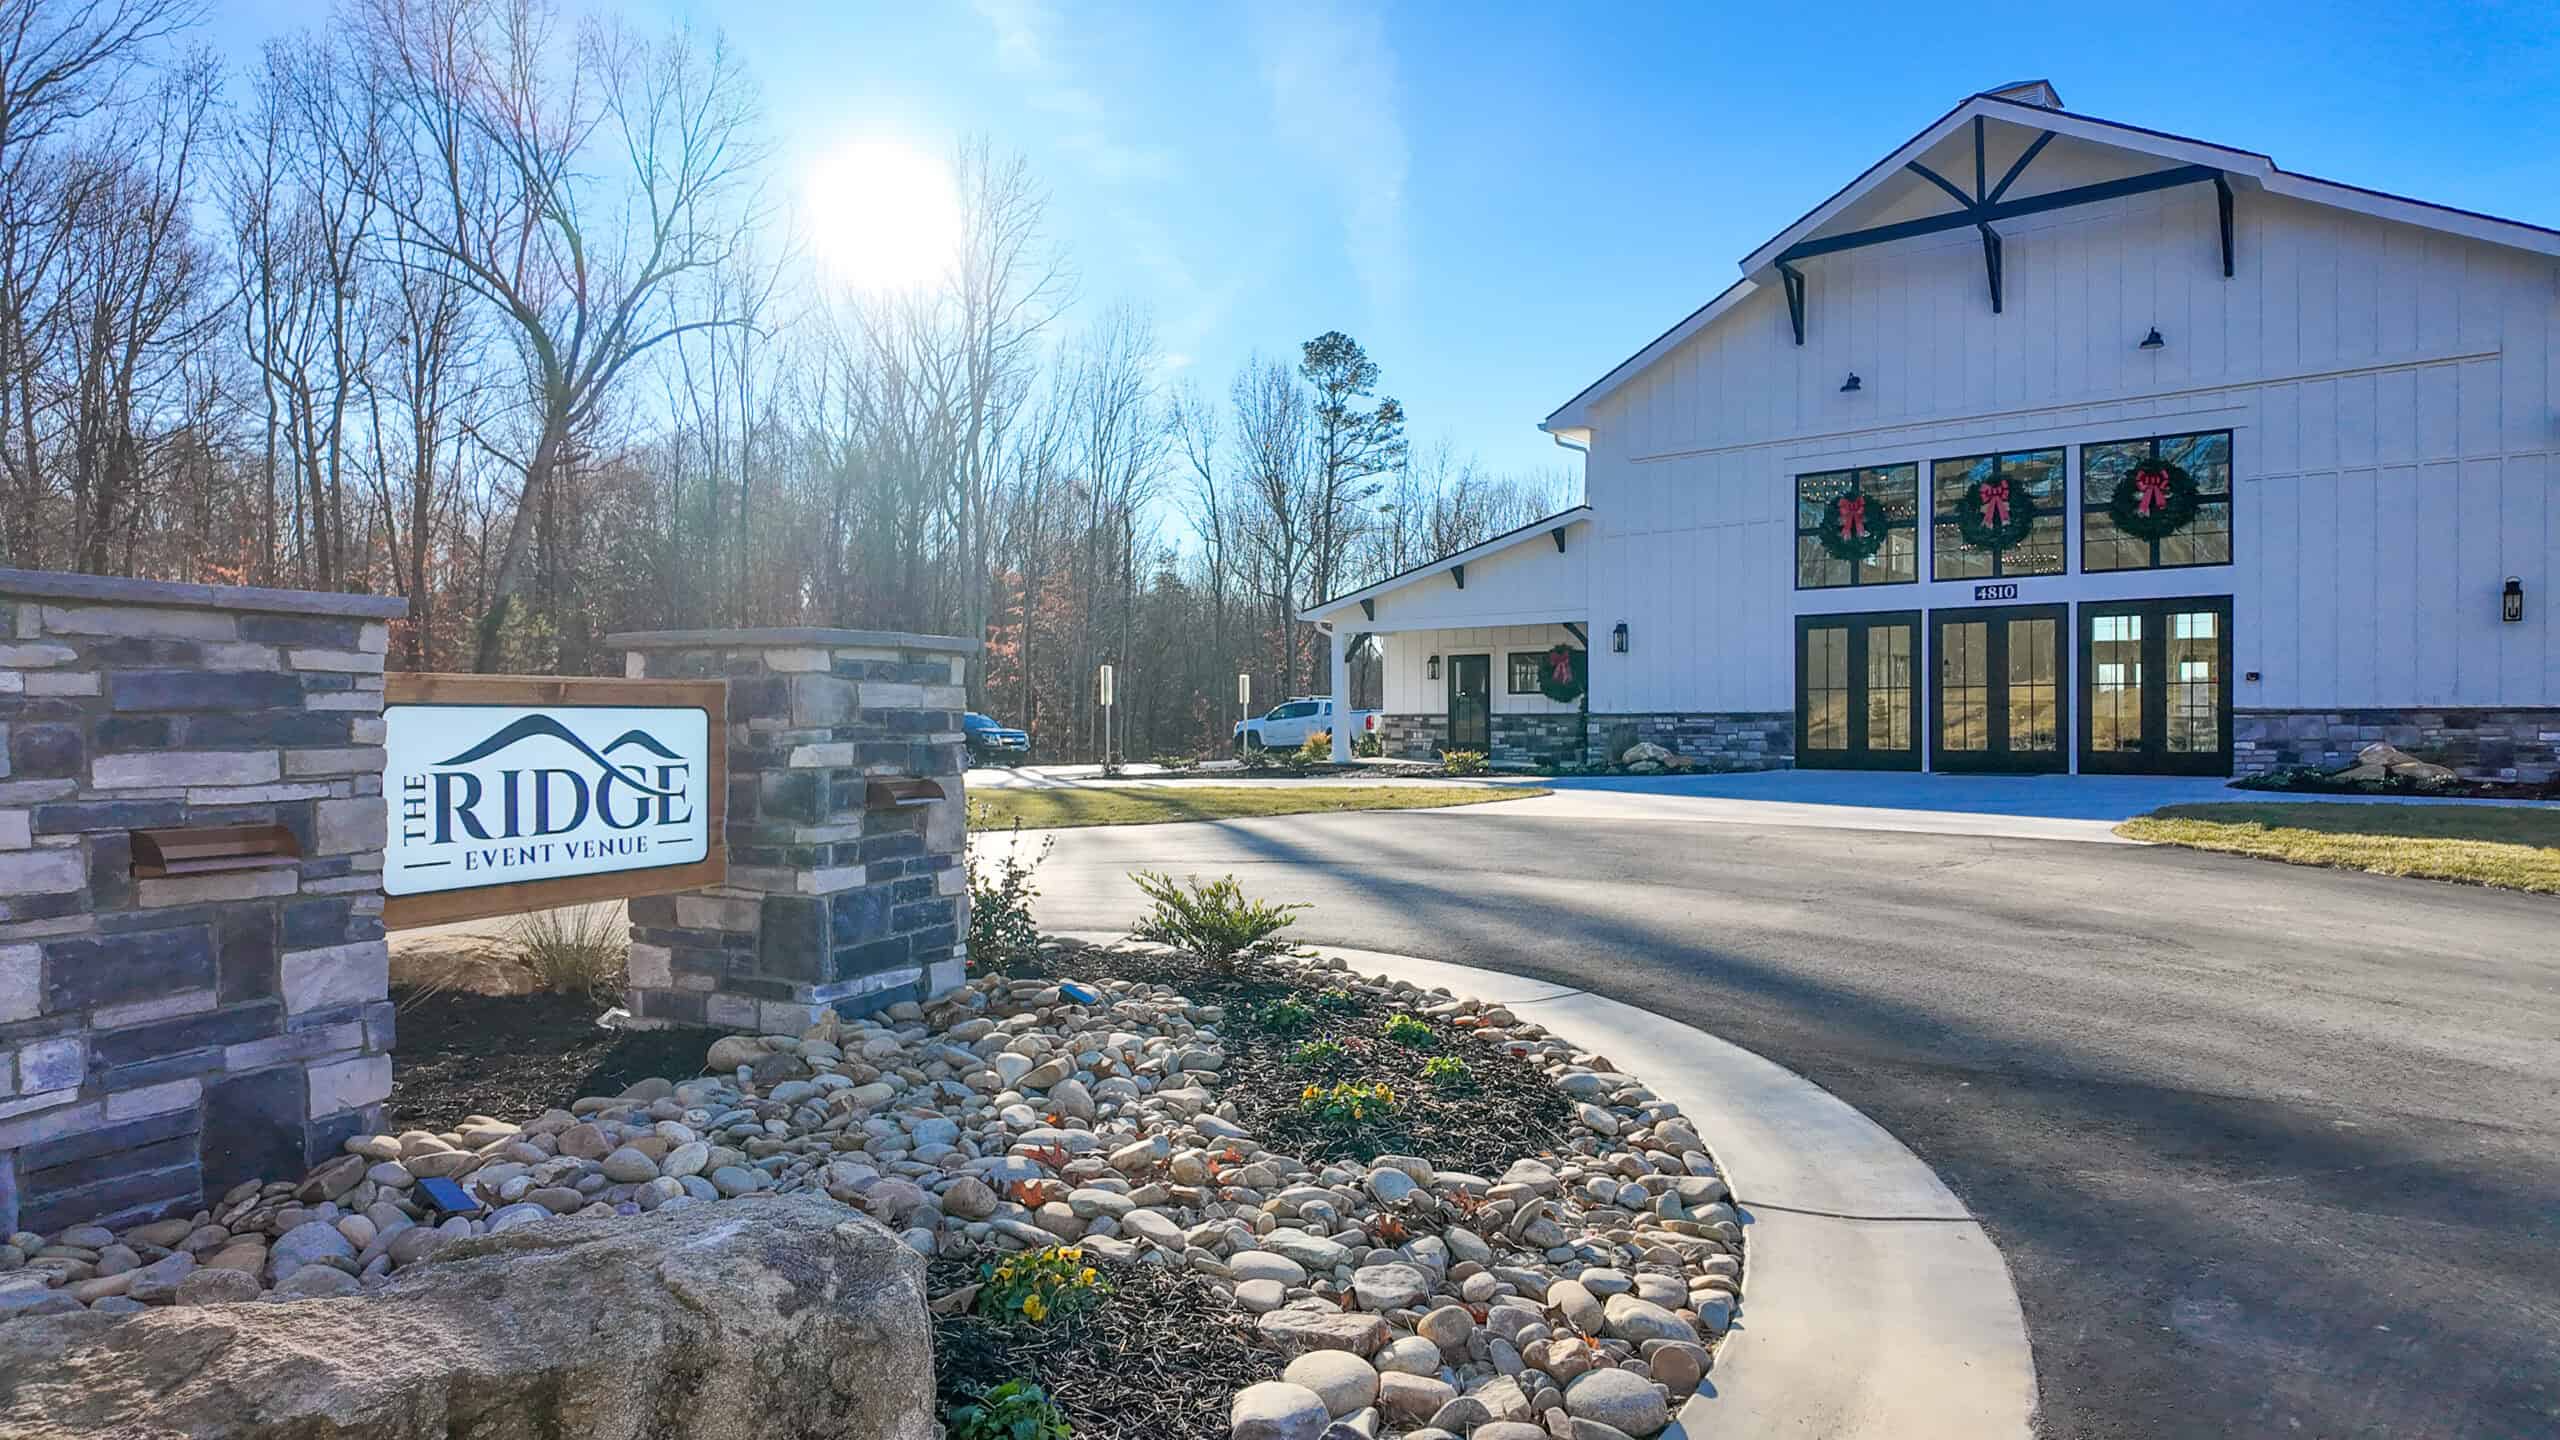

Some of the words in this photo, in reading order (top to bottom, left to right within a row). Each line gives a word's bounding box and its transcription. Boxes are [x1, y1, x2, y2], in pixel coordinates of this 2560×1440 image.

[1977, 585, 2015, 599] 4810
[403, 773, 426, 847] THE
[429, 762, 693, 846] RIDGE
[465, 843, 556, 871] EVENT
[565, 835, 648, 859] VENUE
